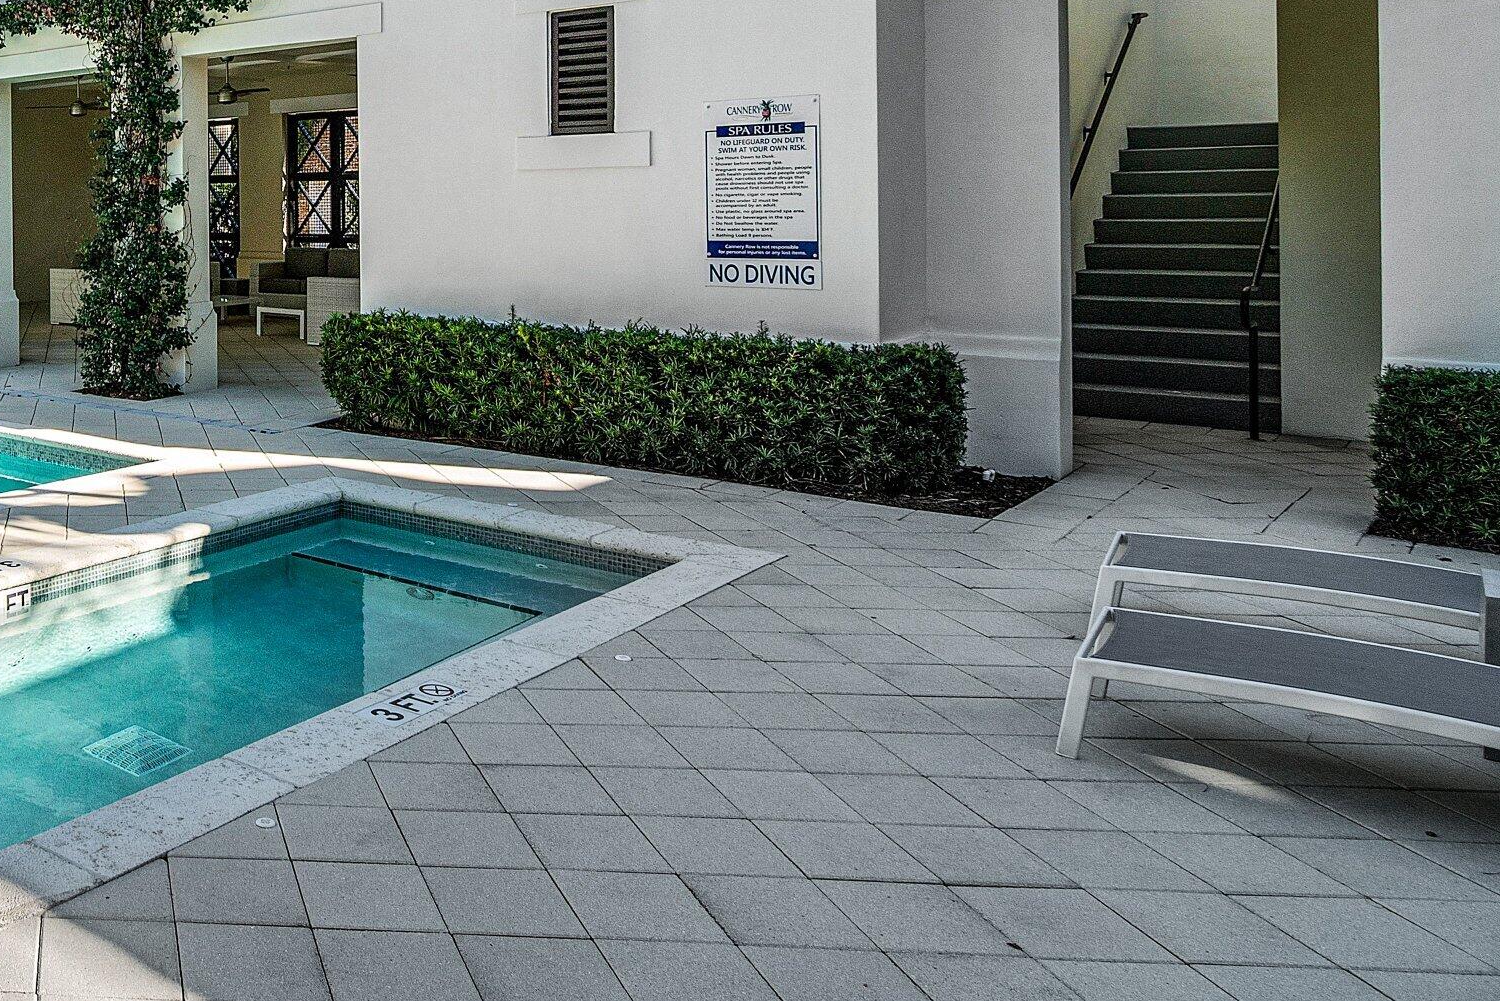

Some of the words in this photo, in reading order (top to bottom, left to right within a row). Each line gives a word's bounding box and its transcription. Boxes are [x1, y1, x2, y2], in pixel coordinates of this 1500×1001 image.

[727, 105, 761, 116] CANNERY
[772, 104, 792, 112] ROW
[728, 126, 750, 136] SPA
[754, 124, 792, 134] RULES
[710, 264, 739, 282] NO
[745, 264, 814, 285] DIVING
[370, 708, 404, 721] 3
